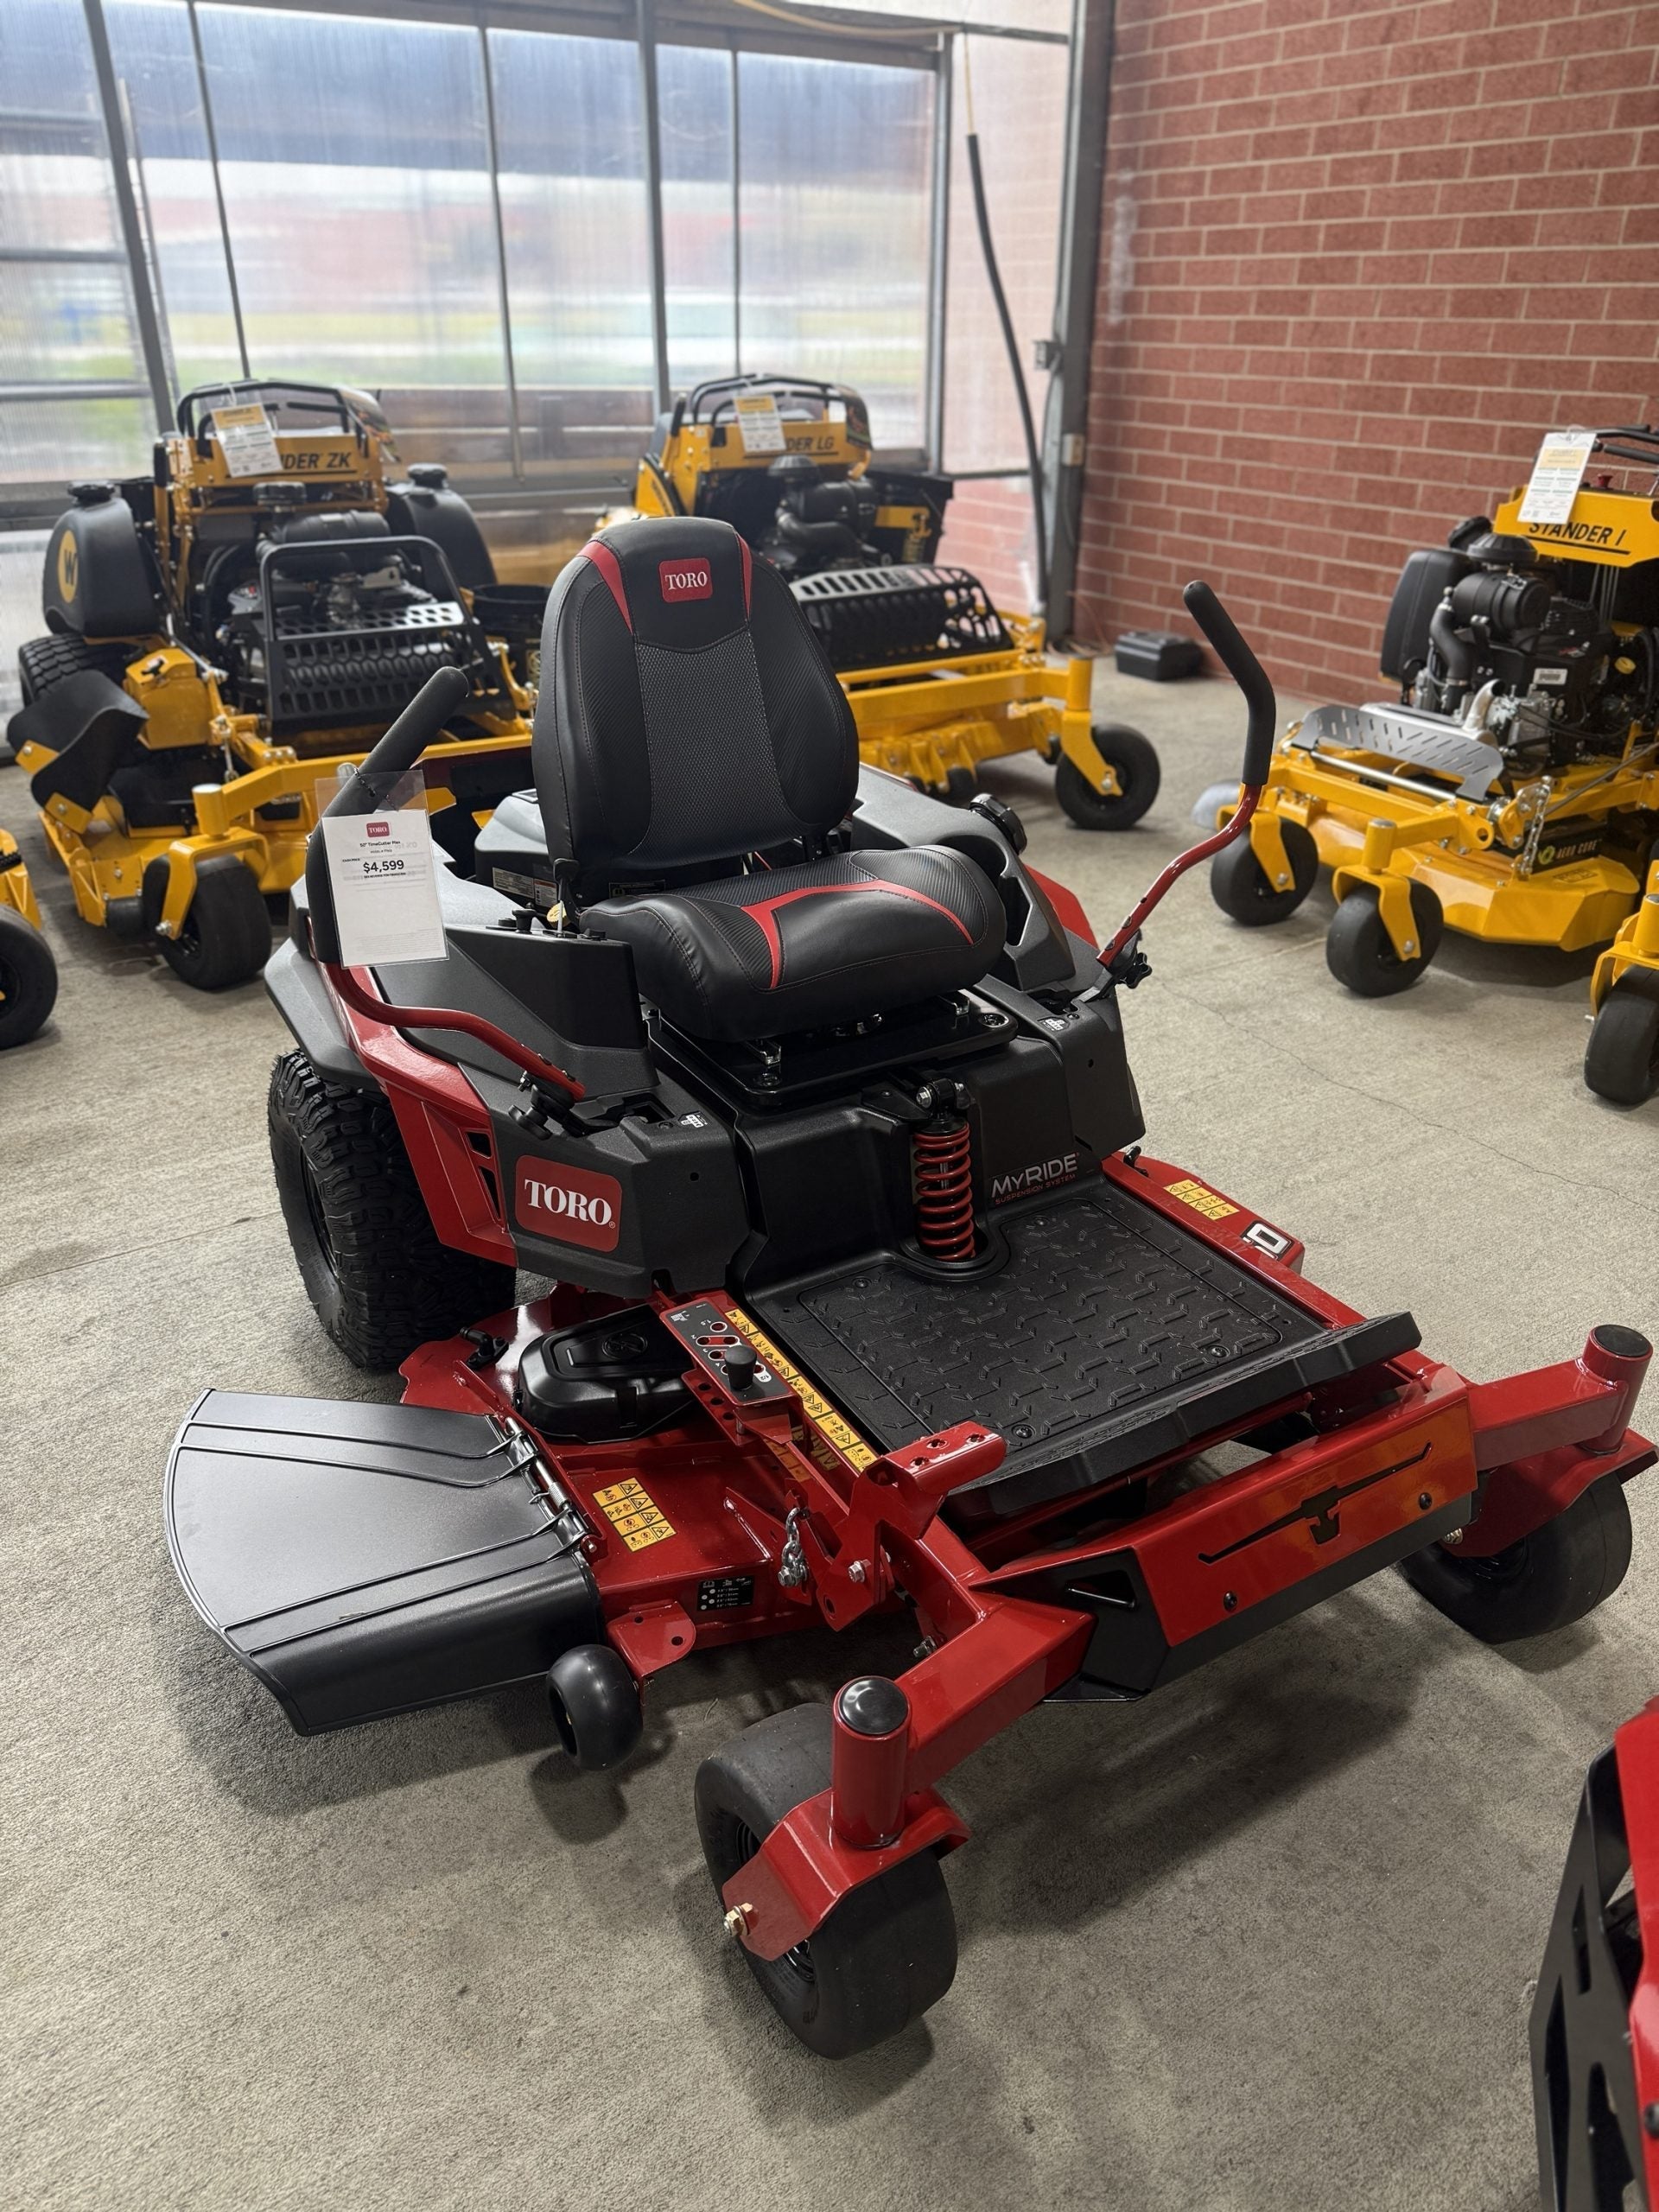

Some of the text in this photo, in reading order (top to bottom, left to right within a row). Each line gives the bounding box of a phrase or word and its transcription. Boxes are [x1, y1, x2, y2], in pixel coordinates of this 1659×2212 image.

[327, 452, 351, 468] ZK
[1529, 521, 1613, 545] STANDER
[664, 571, 708, 590] TORO
[363, 860, 404, 874] $4,599
[995, 1173, 1076, 1205] SUSPENSION SYSTEM
[524, 1179, 613, 1226] TORO
